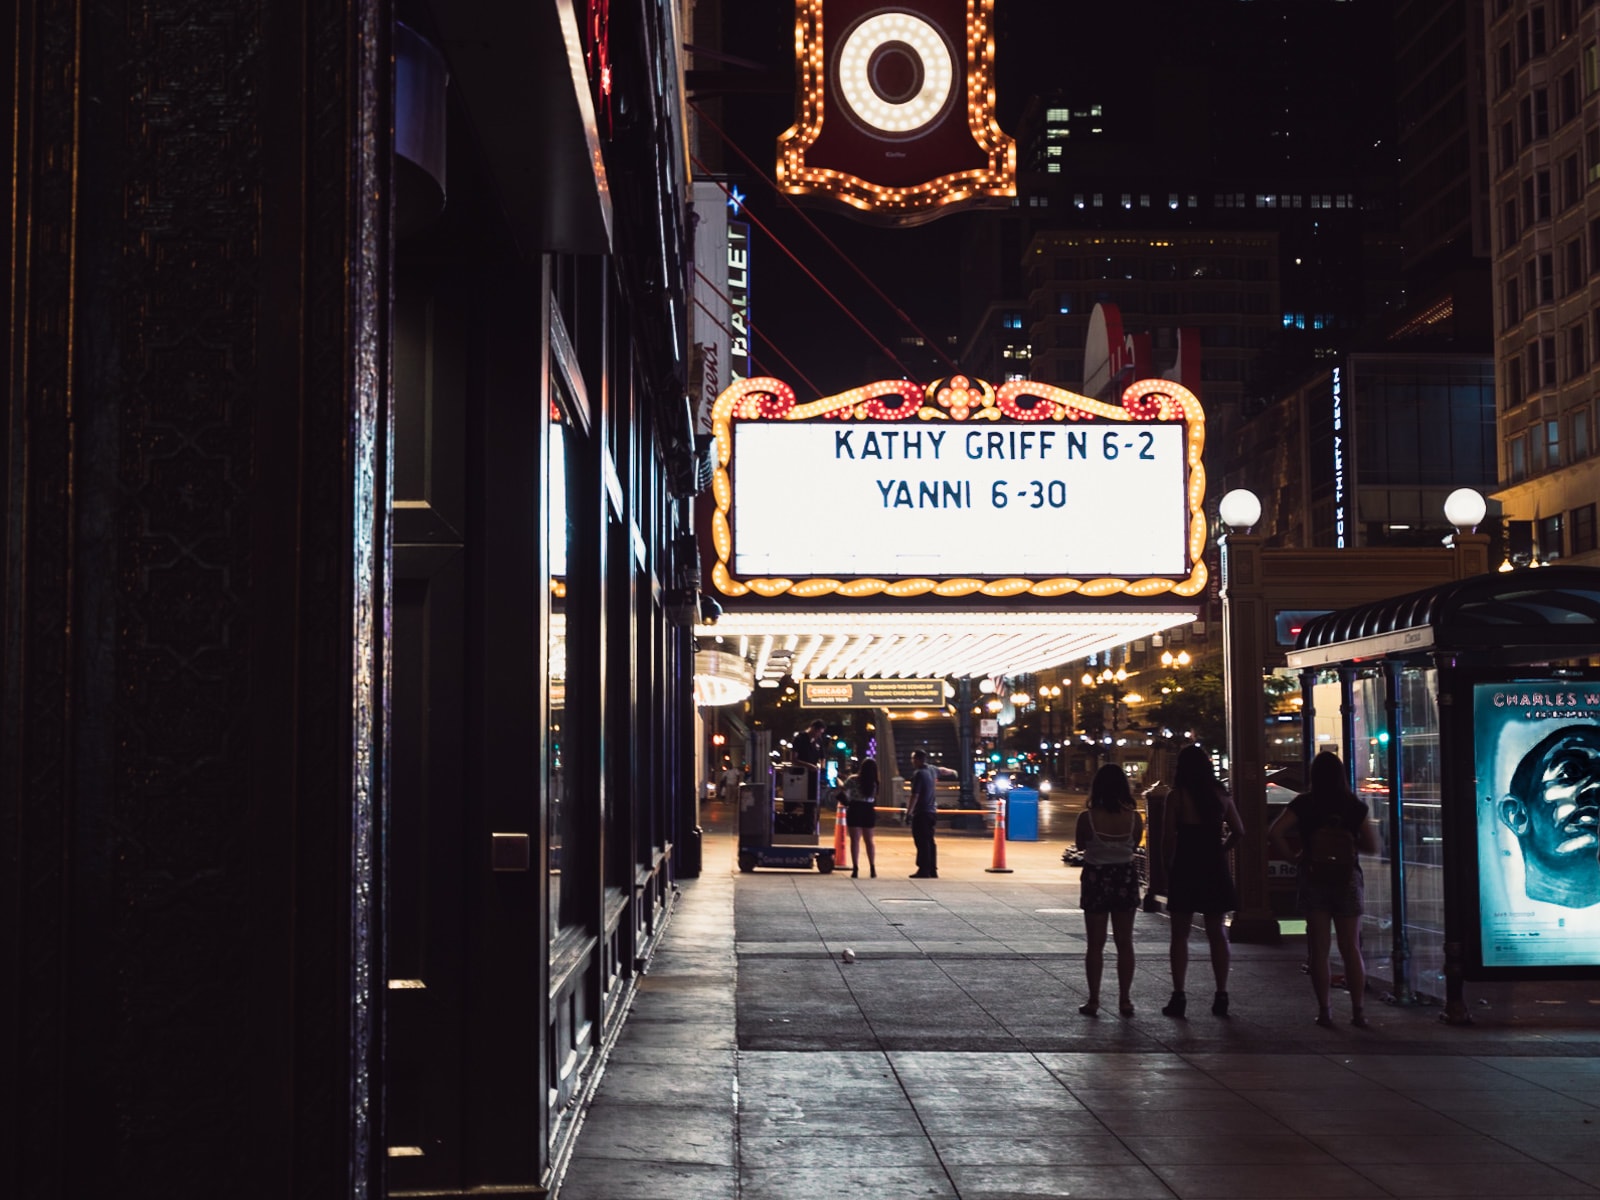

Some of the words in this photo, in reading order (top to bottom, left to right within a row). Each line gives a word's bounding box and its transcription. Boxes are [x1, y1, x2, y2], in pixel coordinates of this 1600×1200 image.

[727, 226, 748, 357] BALLET
[836, 431, 946, 460] KATHY
[1103, 431, 1155, 460] 6-2
[877, 480, 971, 509] YANNI
[1493, 693, 1577, 708] CHARLES
